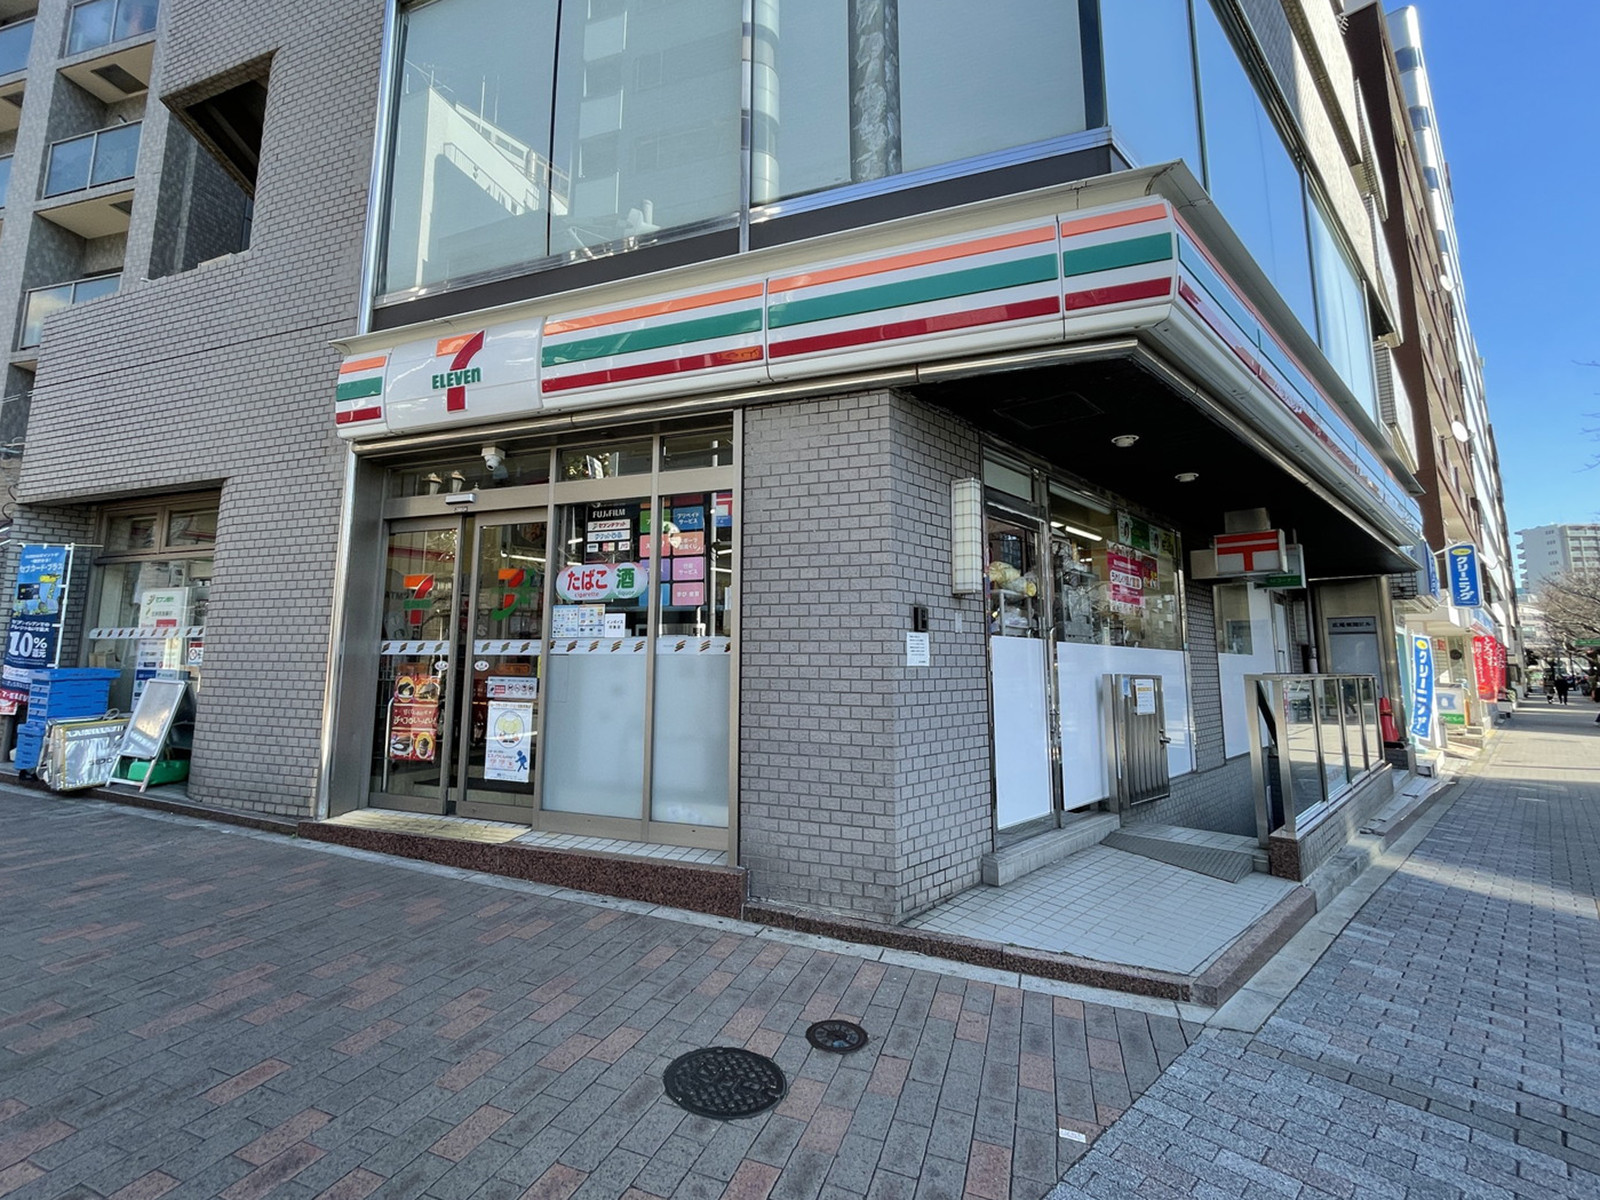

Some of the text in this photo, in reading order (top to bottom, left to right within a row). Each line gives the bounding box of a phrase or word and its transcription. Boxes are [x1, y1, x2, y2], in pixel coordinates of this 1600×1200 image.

[592, 508, 626, 519] FUJIFILM
[567, 567, 635, 591] たばこ 酒
[1456, 556, 1475, 601] クリーニング
[8, 631, 48, 658] 10%
